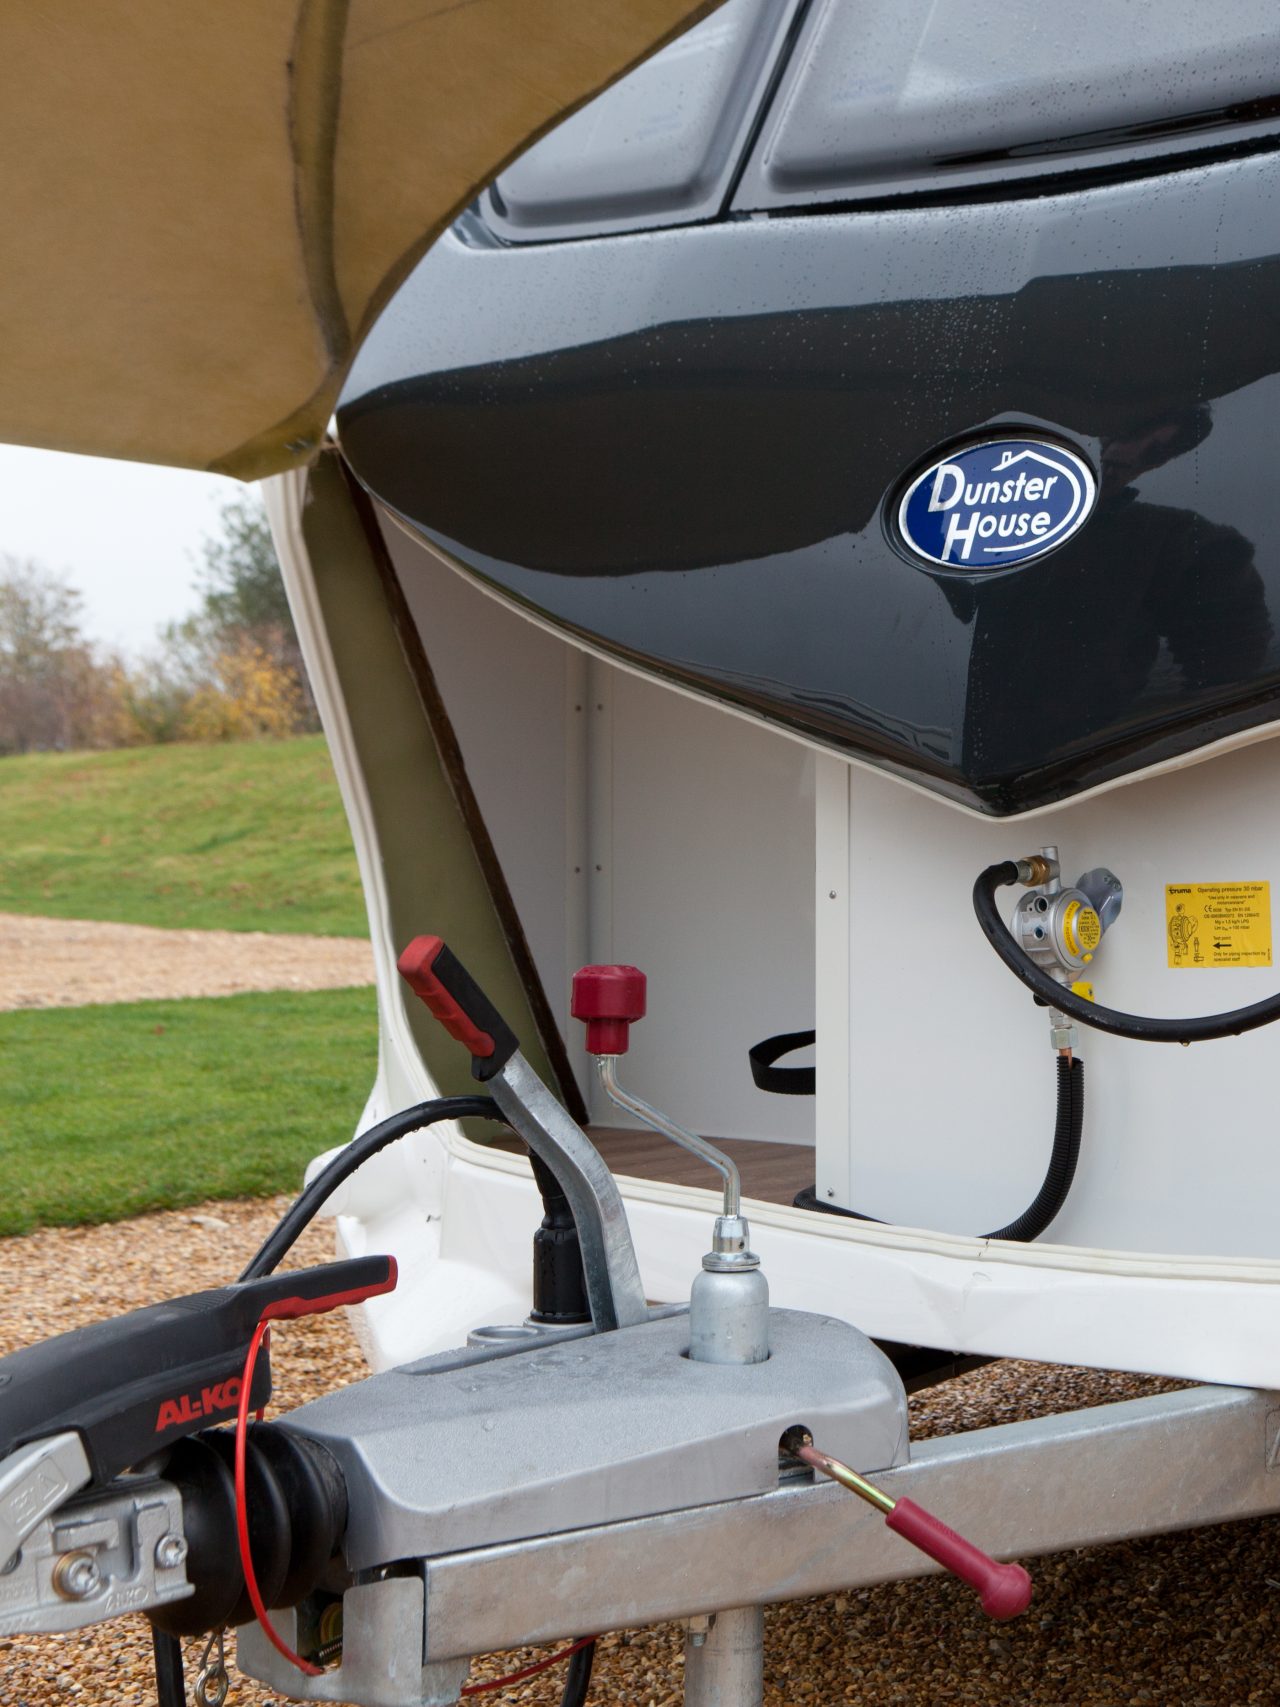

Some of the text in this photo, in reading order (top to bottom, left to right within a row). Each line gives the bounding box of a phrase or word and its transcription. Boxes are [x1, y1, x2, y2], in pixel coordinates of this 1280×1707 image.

[927, 464, 1058, 513] Dunster
[941, 511, 1051, 561] House
[156, 1376, 243, 1432] AL-KO
